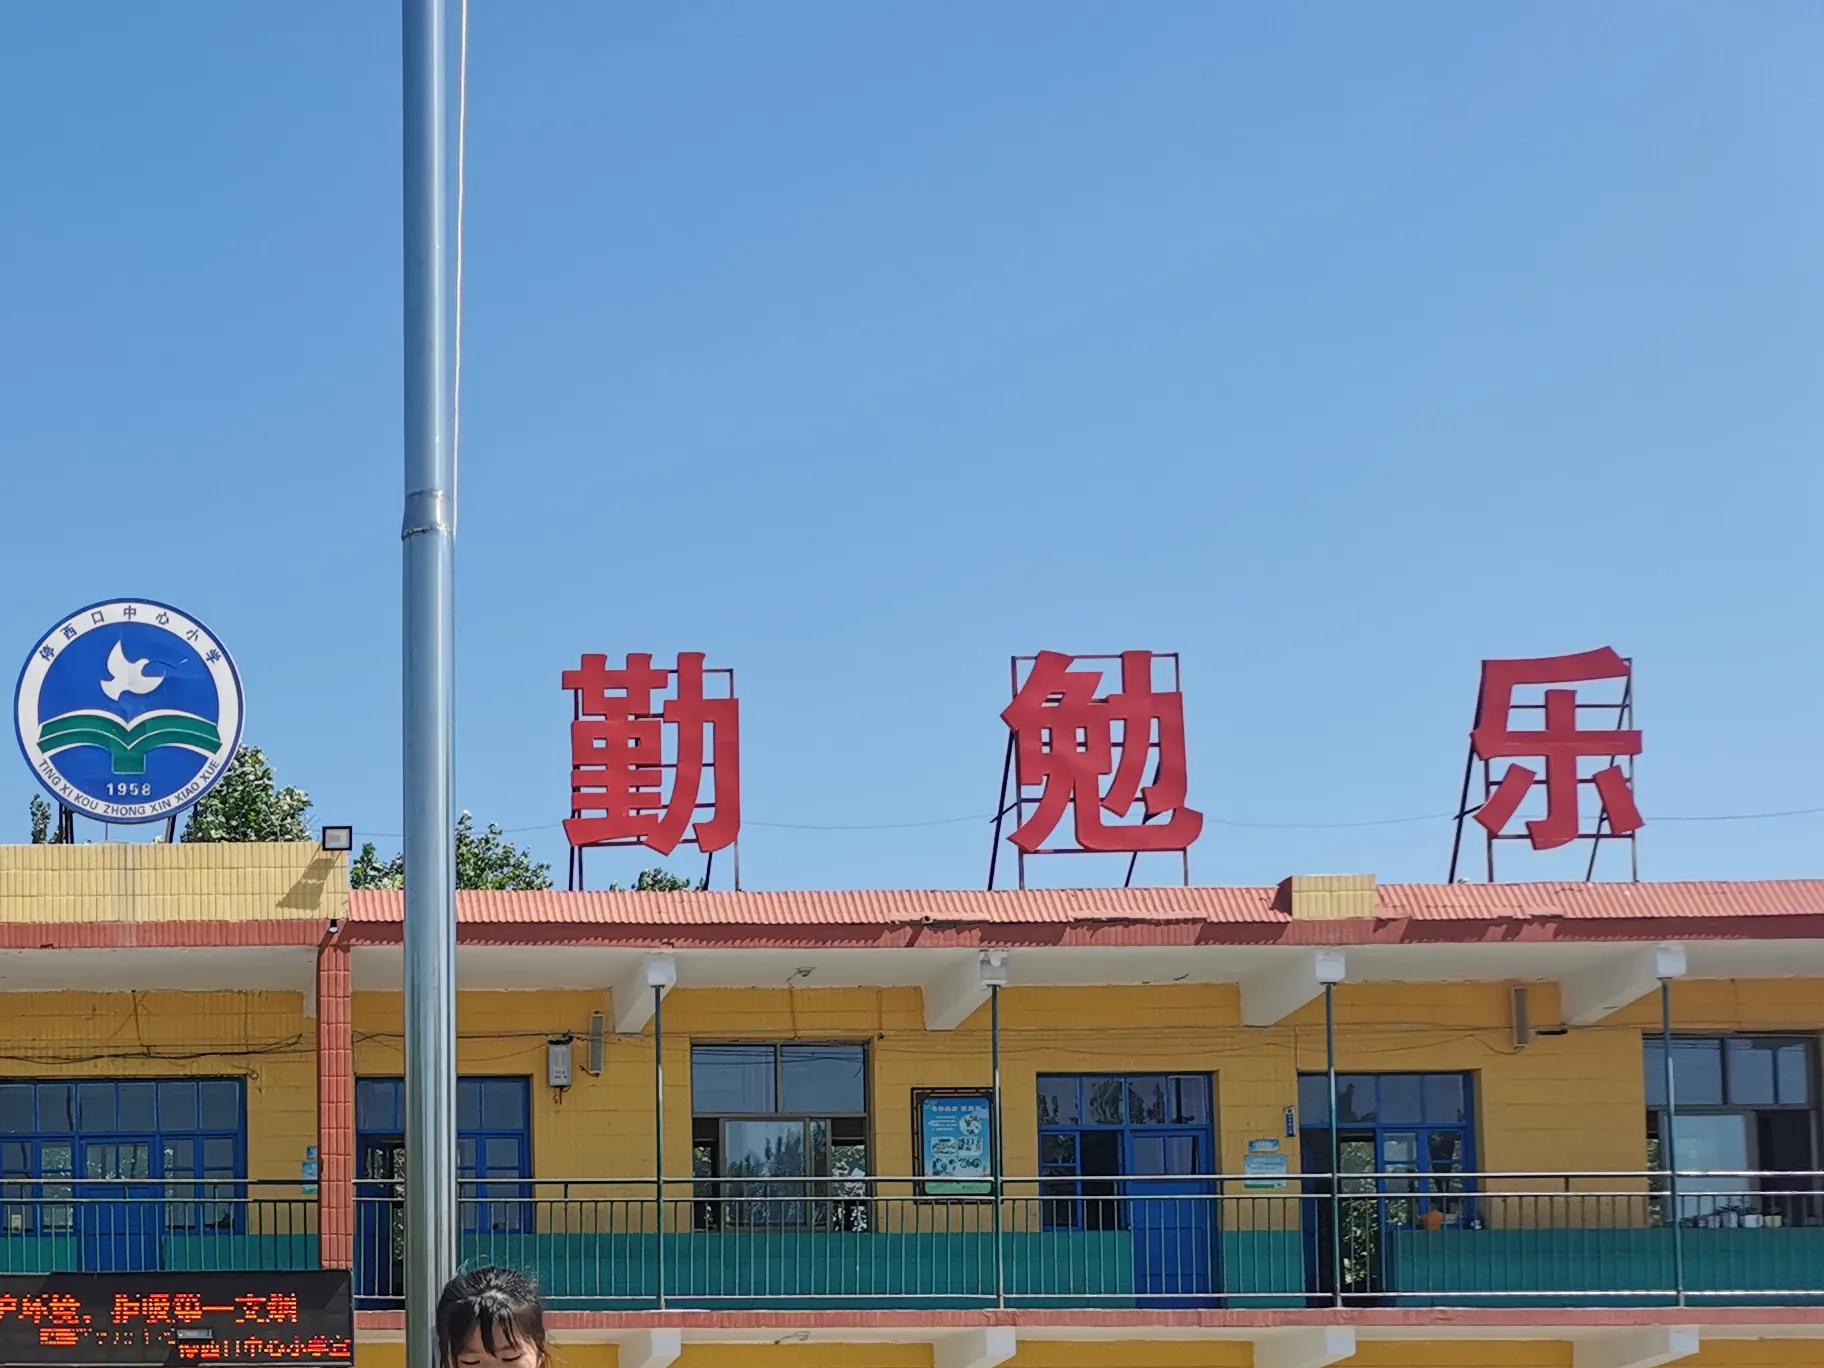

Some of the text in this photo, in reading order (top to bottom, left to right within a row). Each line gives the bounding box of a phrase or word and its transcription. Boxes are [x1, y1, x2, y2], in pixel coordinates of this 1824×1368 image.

[39, 604, 222, 665] 停西口中心小学
[37, 759, 221, 817] TING XI KOU ZHONG XIN XIAO XUE
[106, 782, 152, 797] 1958
